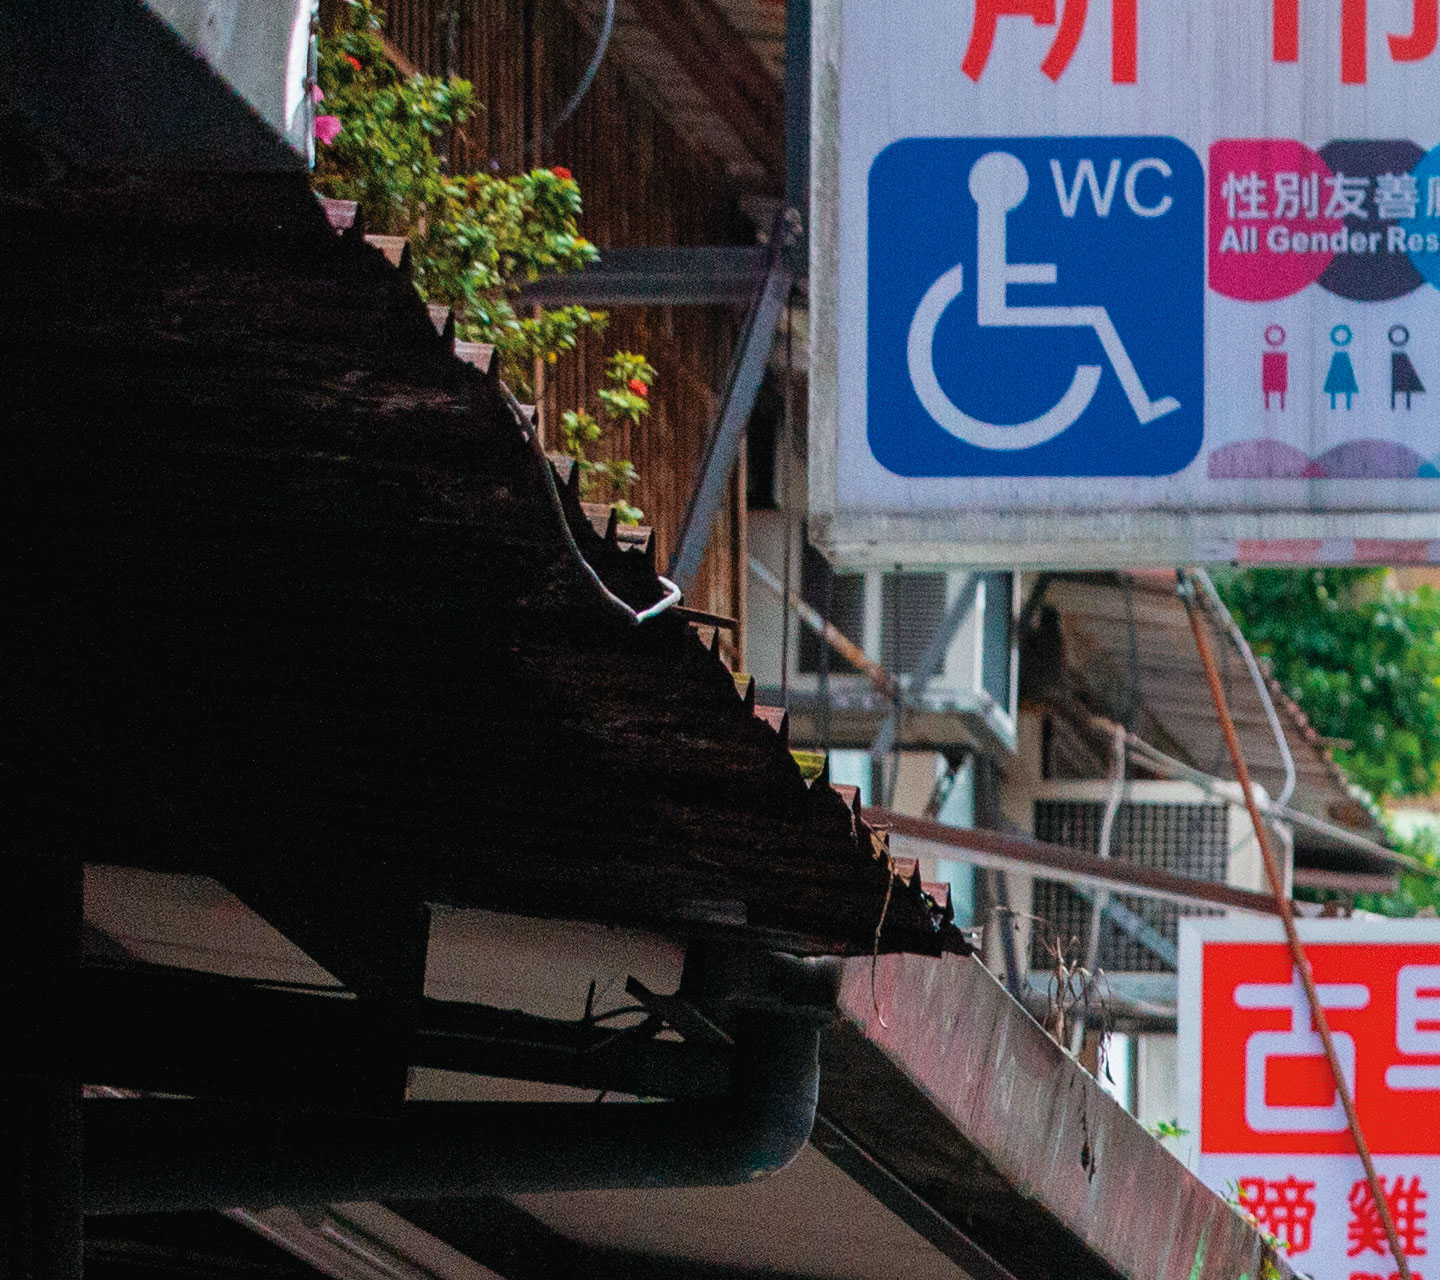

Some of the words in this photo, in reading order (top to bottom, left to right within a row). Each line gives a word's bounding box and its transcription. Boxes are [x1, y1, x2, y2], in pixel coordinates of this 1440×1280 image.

[1051, 158, 1173, 218] WC
[1219, 224, 1261, 255] All
[1266, 224, 1382, 256] Gender
